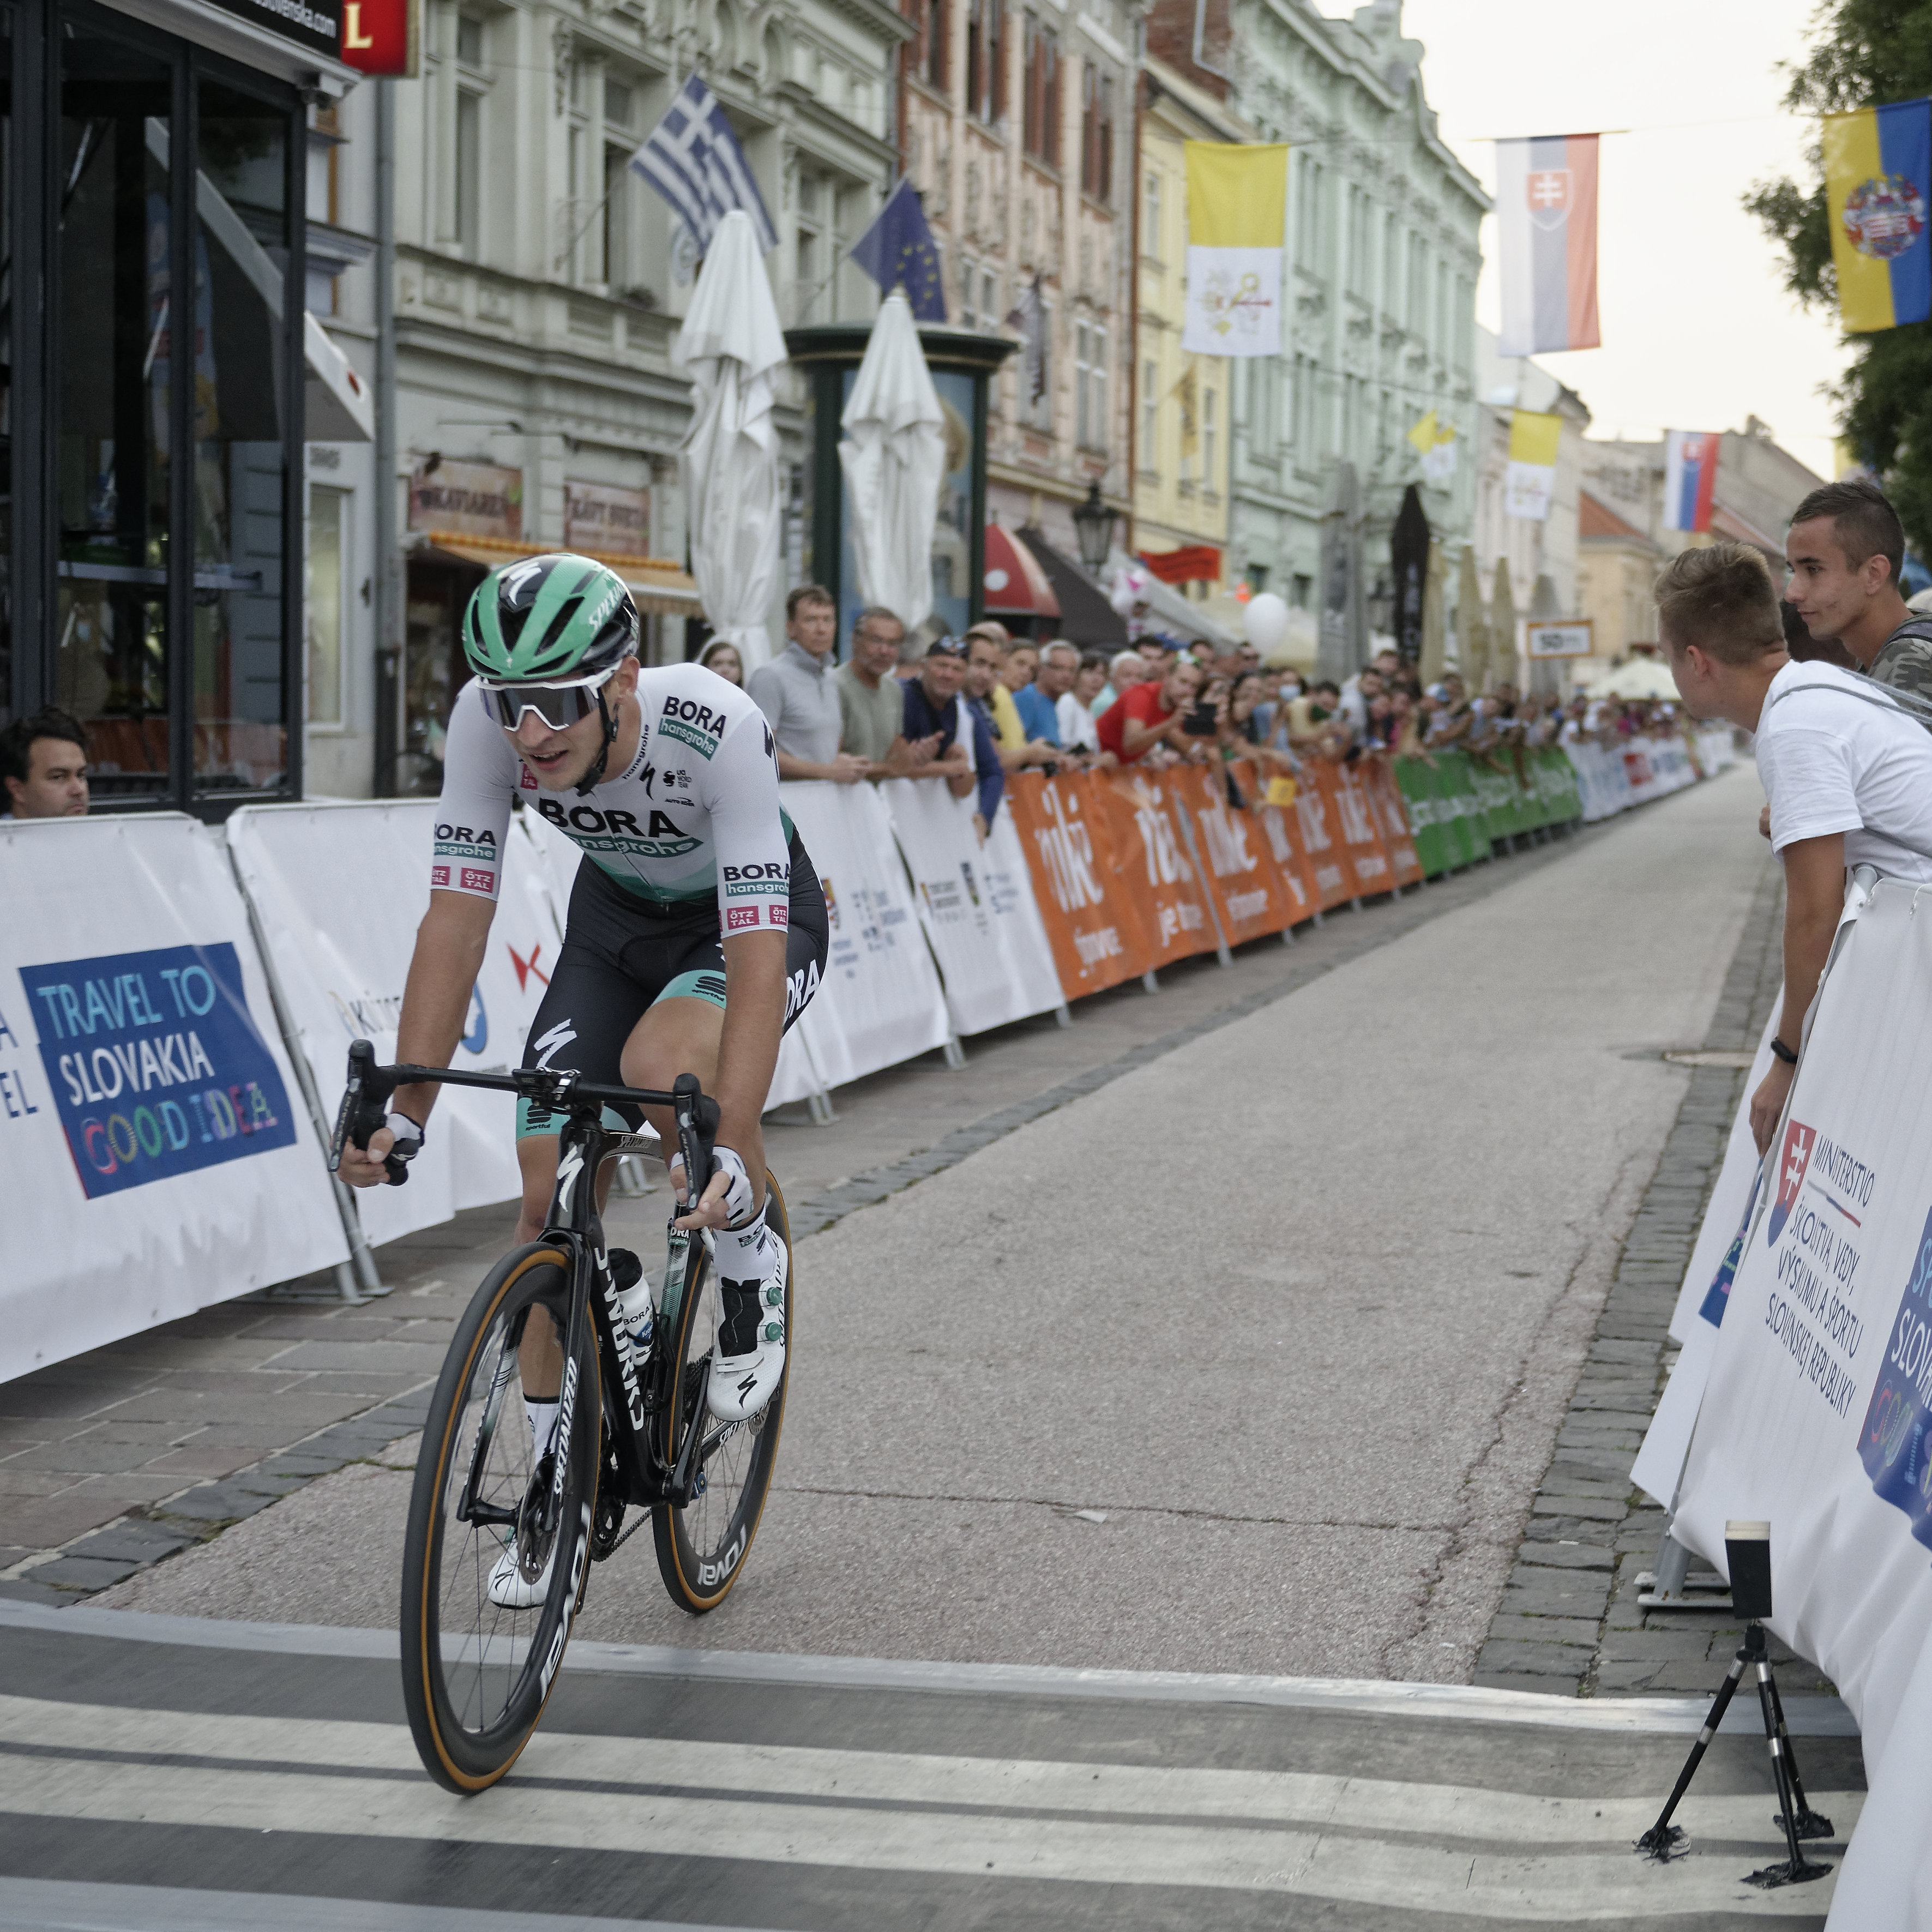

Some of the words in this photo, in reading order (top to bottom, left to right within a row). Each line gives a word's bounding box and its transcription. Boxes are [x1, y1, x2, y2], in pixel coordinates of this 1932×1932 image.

[345, 4, 373, 49] L
[660, 718, 715, 755] hansgrohe
[663, 696, 727, 739] BORA
[622, 724, 649, 780] hansgrohe
[434, 823, 497, 846] ORA
[538, 797, 689, 838] BORA
[434, 845, 493, 858] nsgrohe
[569, 836, 694, 855] nsgrohe
[465, 870, 491, 883] ÖTZ
[465, 880, 490, 889] TAL
[730, 910, 754, 919] ÖTZ
[36, 972, 162, 1039] TRAVEL
[160, 965, 216, 1018] TO
[783, 959, 820, 1027] ORA
[59, 1031, 215, 1106] SLOVAKIA
[81, 1099, 190, 1175] GOOD
[188, 1081, 279, 1143] IDEA
[525, 1123, 551, 1131] sportful
[670, 1226, 689, 1239] ORA
[1833, 1238, 1861, 1296] VEDY,
[1778, 1244, 1822, 1314] VÝSKUMU
[1815, 1287, 1828, 1323] A
[1824, 1286, 1864, 1359] ŠPORTU
[1766, 1292, 1814, 1379] SLOVENSKEJ
[1807, 1341, 1856, 1419] REPUBLIKY
[554, 1356, 577, 1497] SPECIALIZED
